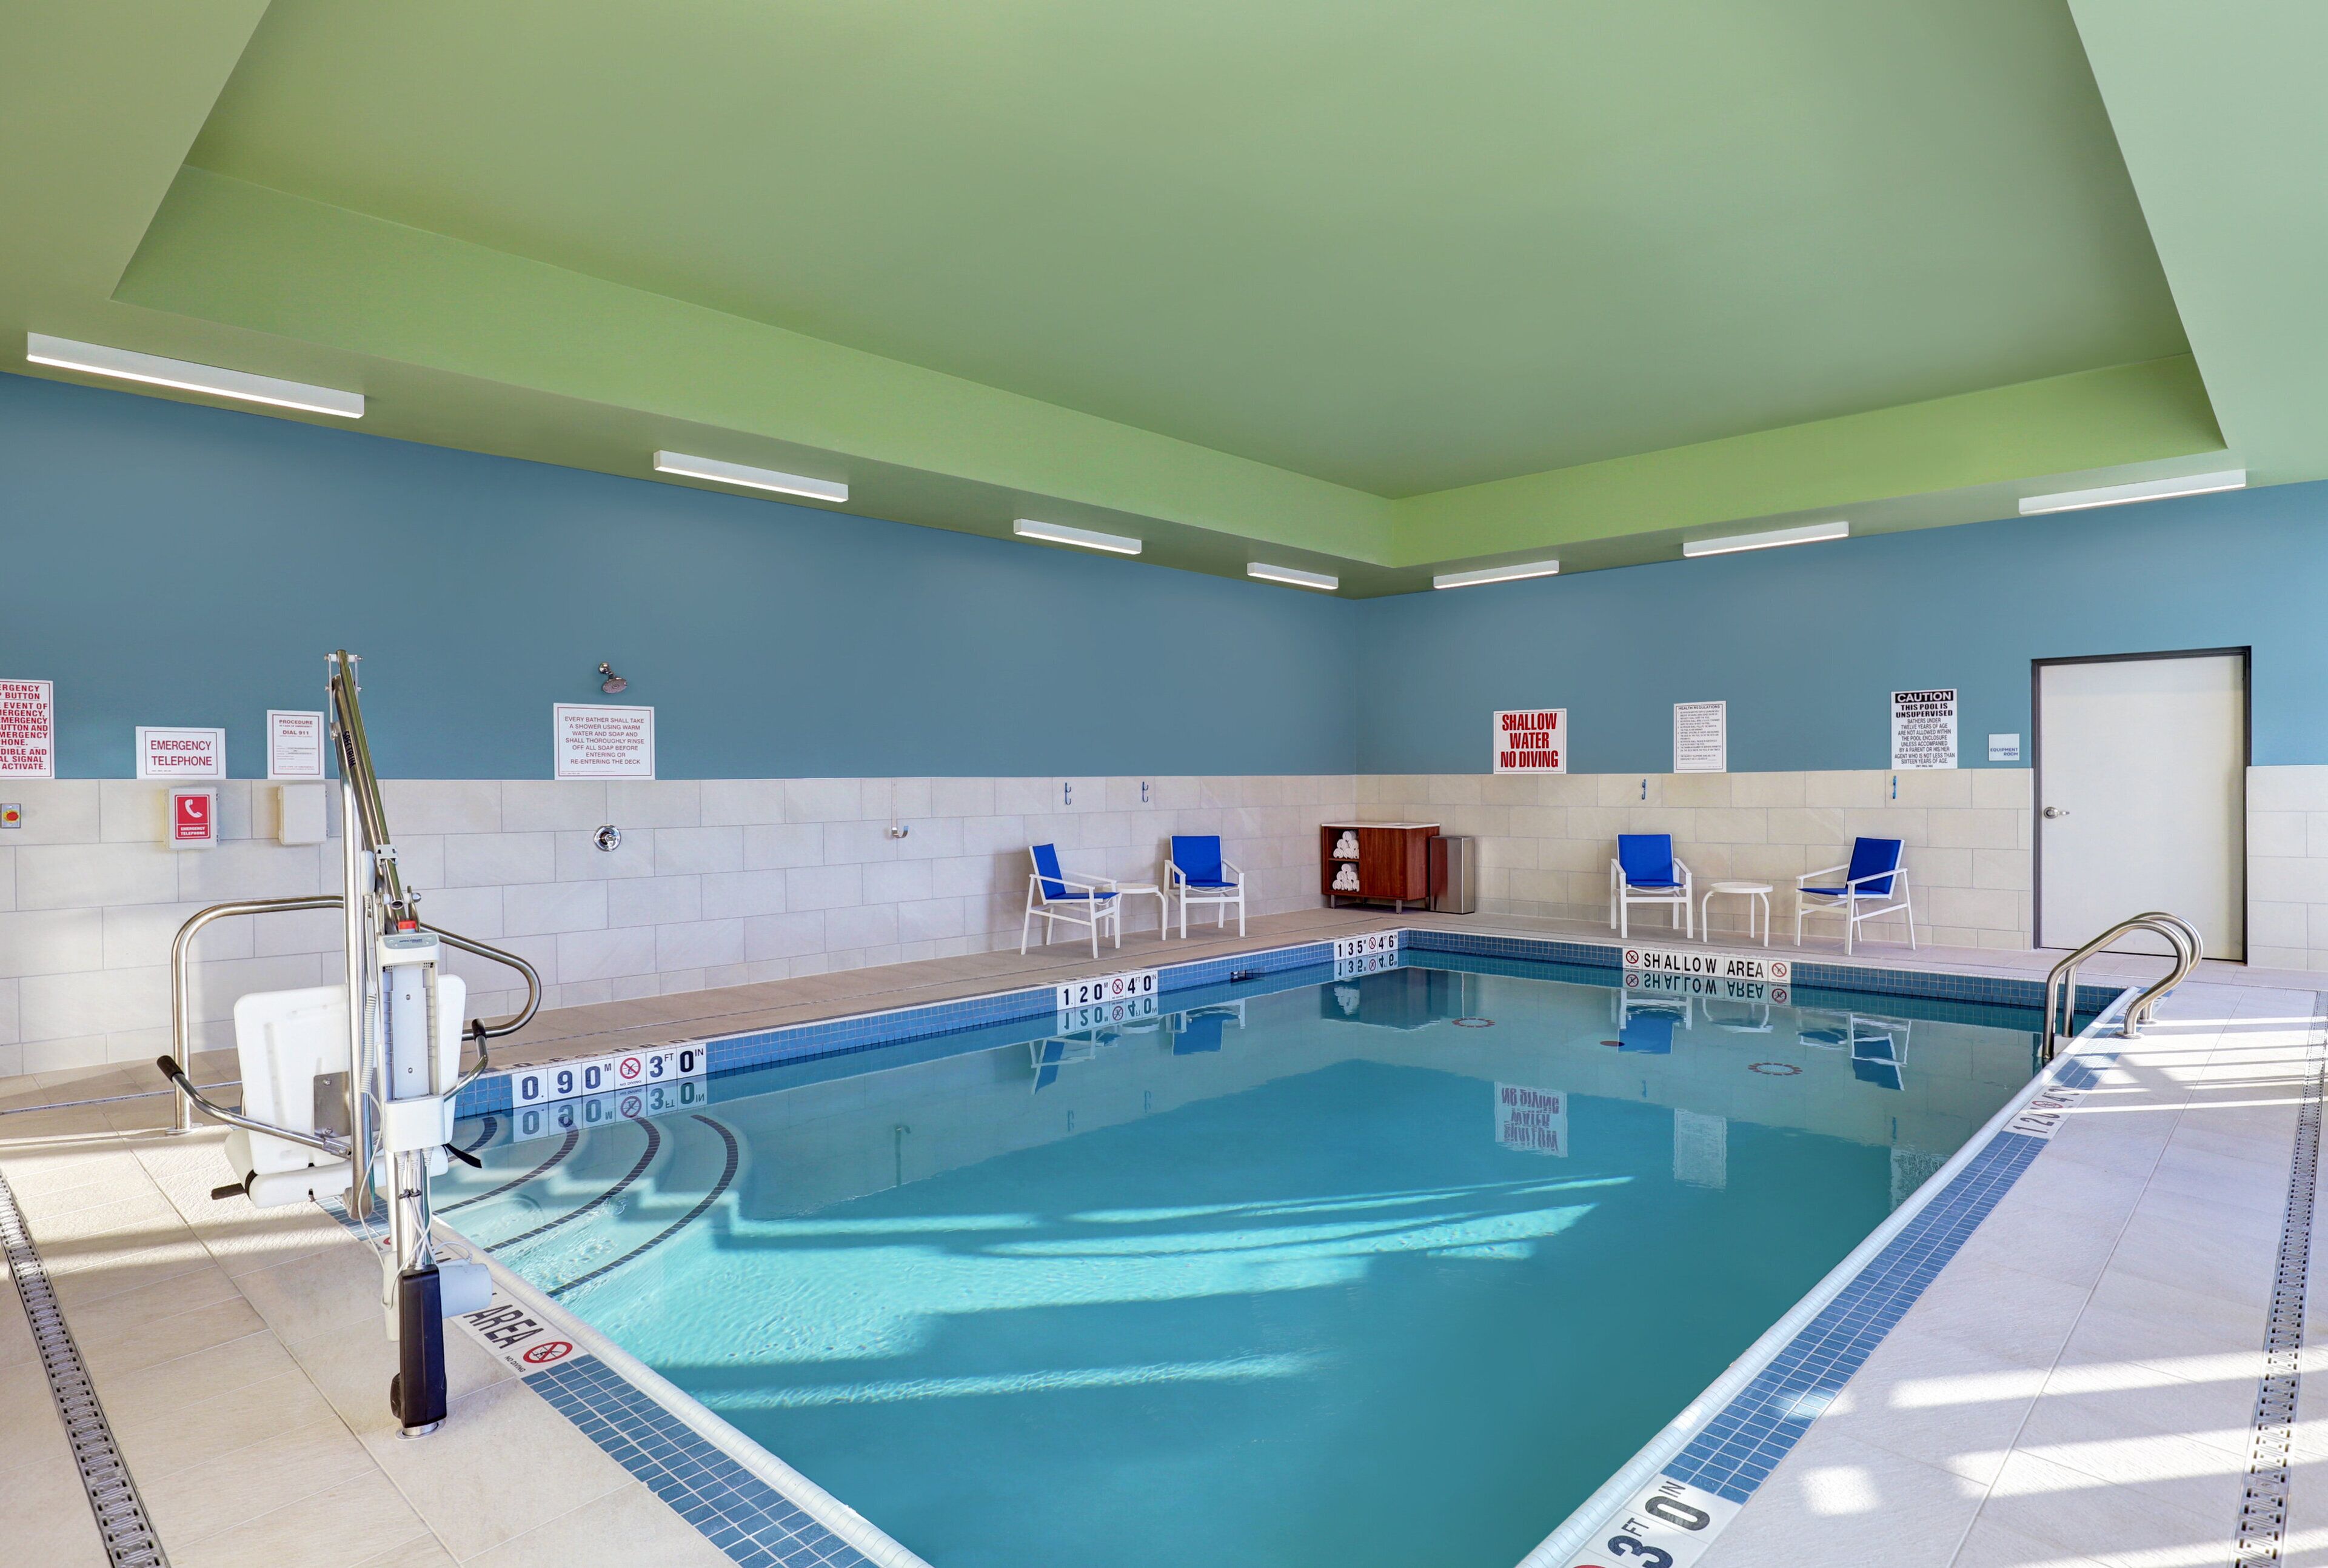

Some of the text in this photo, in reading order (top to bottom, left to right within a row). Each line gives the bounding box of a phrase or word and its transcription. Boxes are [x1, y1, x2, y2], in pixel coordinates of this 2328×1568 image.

[1897, 692, 1951, 702] CAUTION
[1502, 713, 1557, 731] SHALLOW
[151, 740, 211, 750] EMERGENCY
[1510, 732, 1549, 749] WATER
[343, 731, 356, 769] SPECTRUM
[1500, 750, 1559, 768] NO DIVING
[152, 756, 212, 766] TELEPHONE
[1379, 936, 1384, 950] 4
[1388, 935, 1394, 948] 6
[1644, 952, 1764, 978] SHALLOW AREA
[1128, 978, 1136, 994] 4
[1143, 975, 1151, 992] 0
[522, 1066, 601, 1101] 0.90
[649, 1056, 663, 1078] 3
[664, 1053, 674, 1062] FT
[680, 1050, 694, 1072] 0
[695, 1048, 704, 1056] IN
[463, 1304, 544, 1349] AREA
[504, 1355, 526, 1372] NO DIVING
[1607, 1481, 1710, 1568] 3 FT 0 IN
